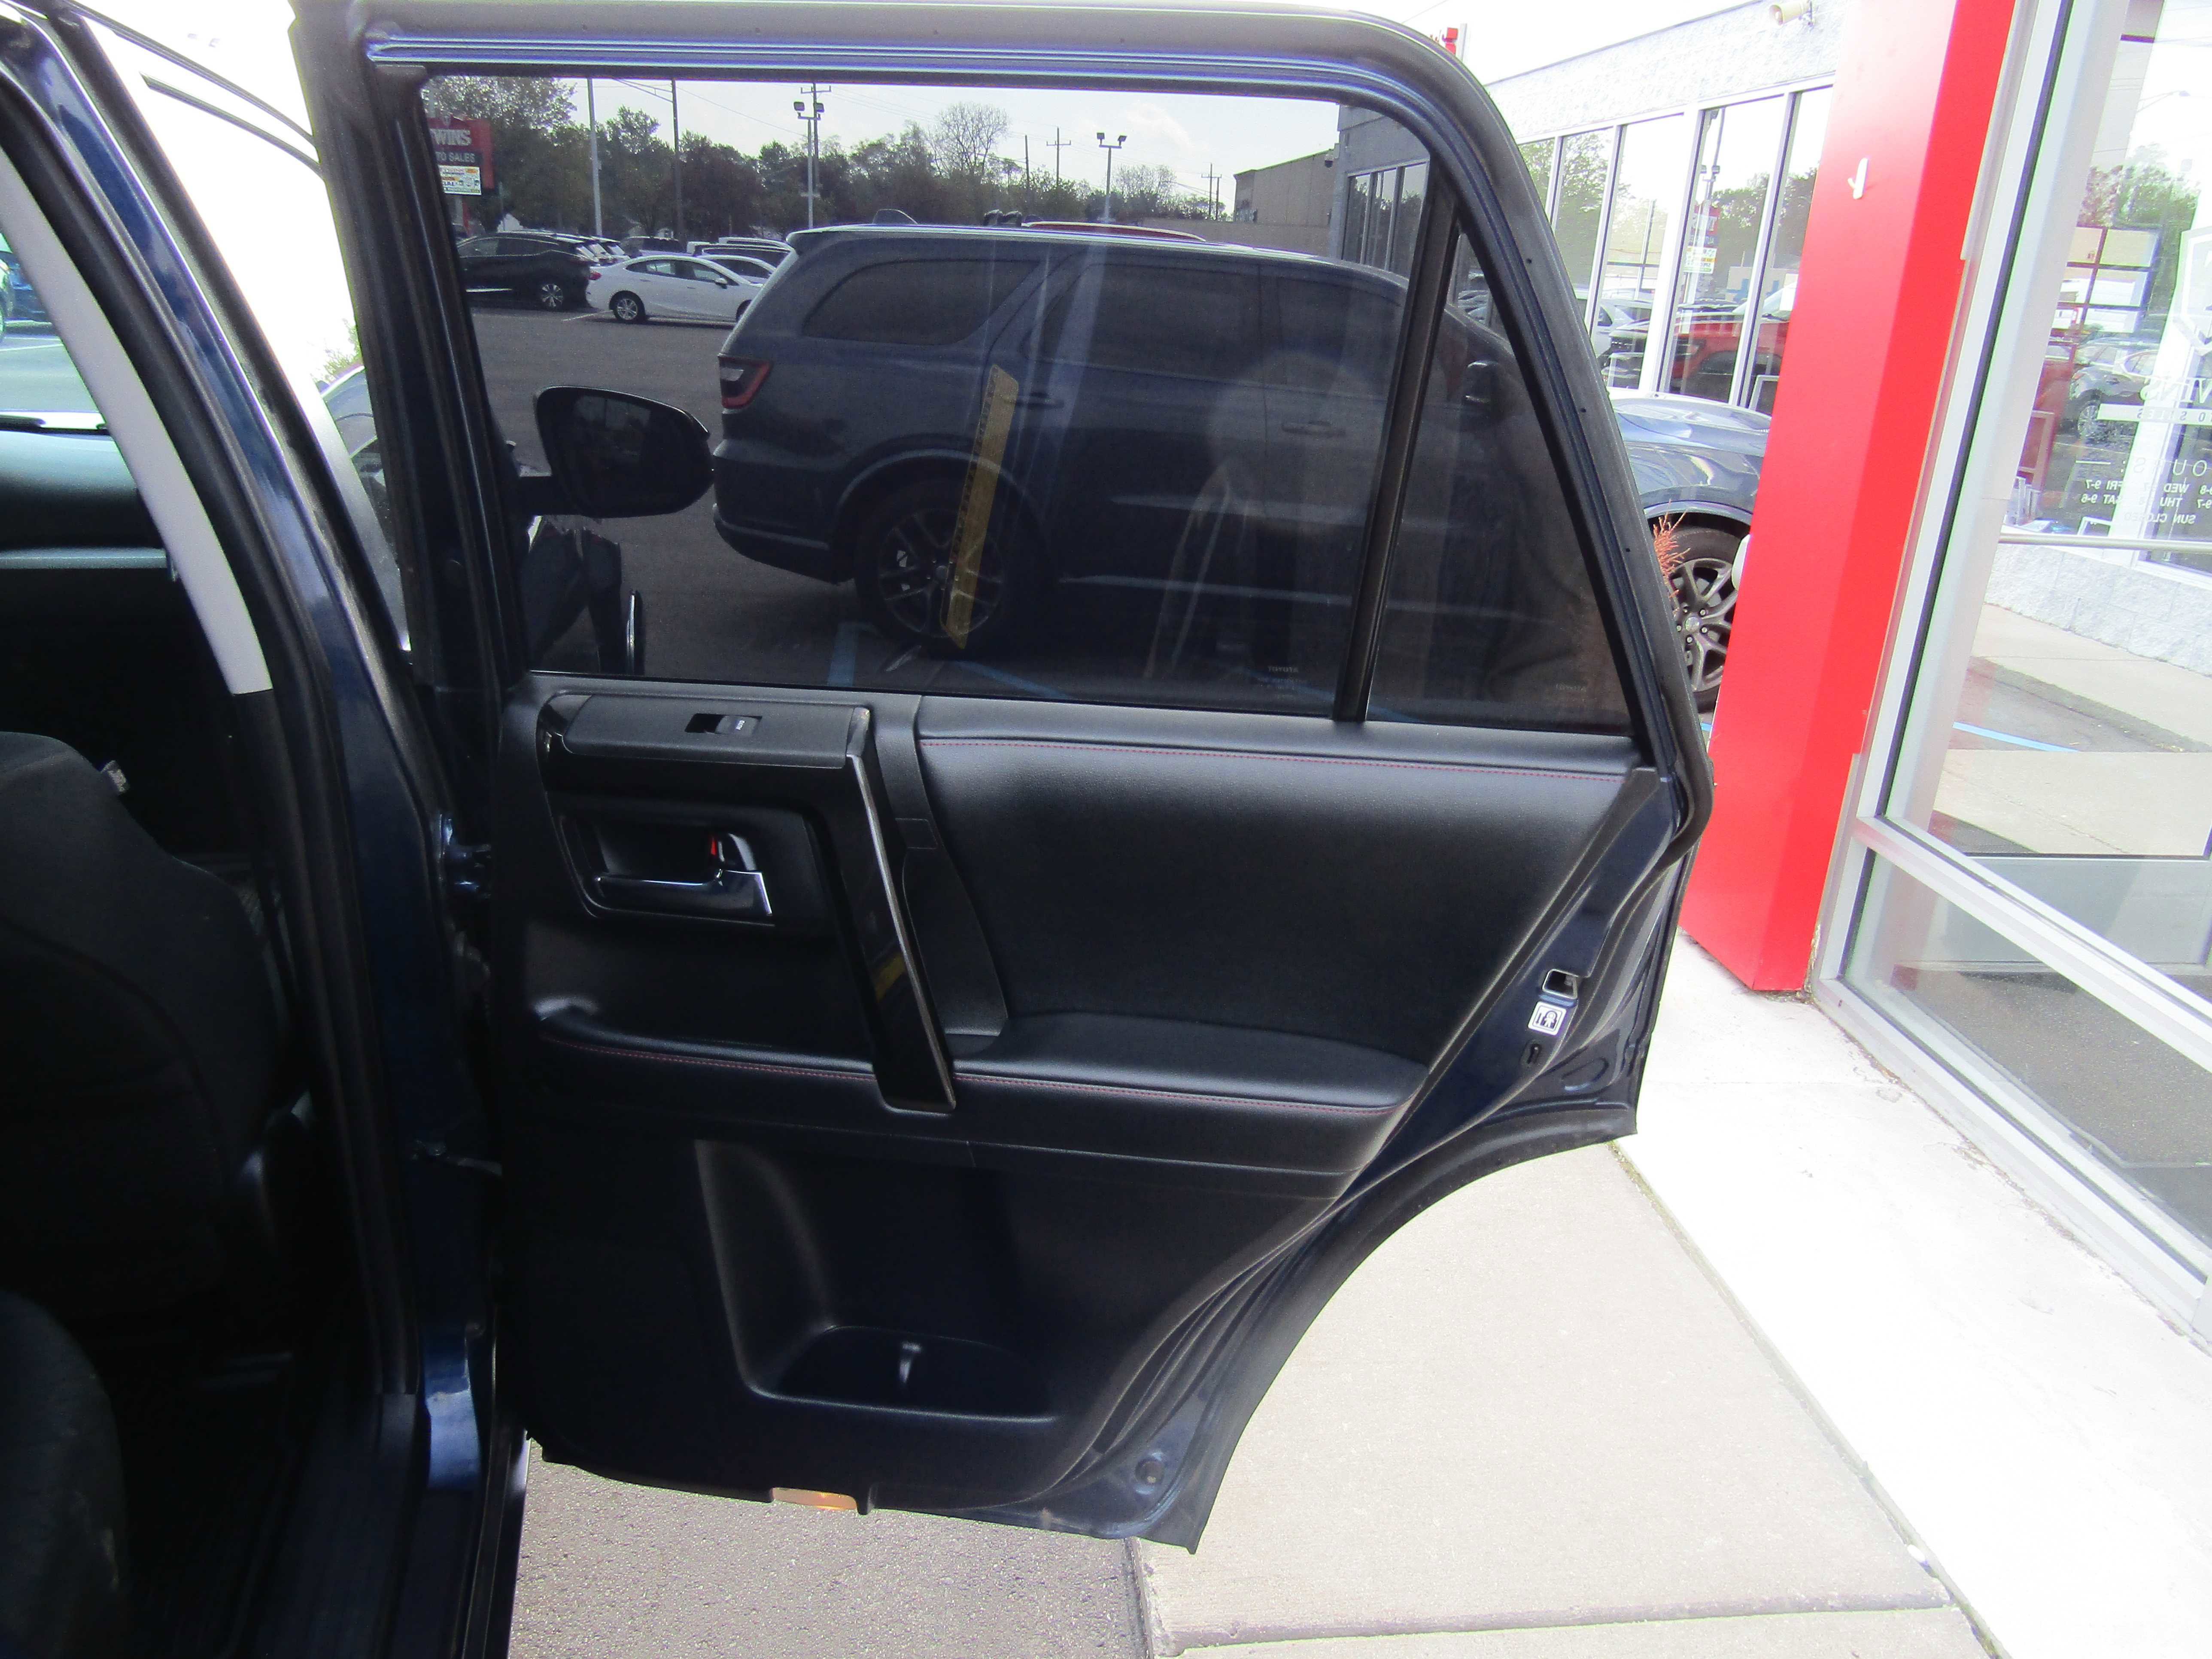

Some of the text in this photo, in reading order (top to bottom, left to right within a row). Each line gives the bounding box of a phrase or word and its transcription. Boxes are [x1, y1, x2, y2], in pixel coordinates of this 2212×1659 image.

[430, 128, 472, 146] WINS
[449, 152, 475, 163] SALES
[735, 720, 745, 730] AUTO
